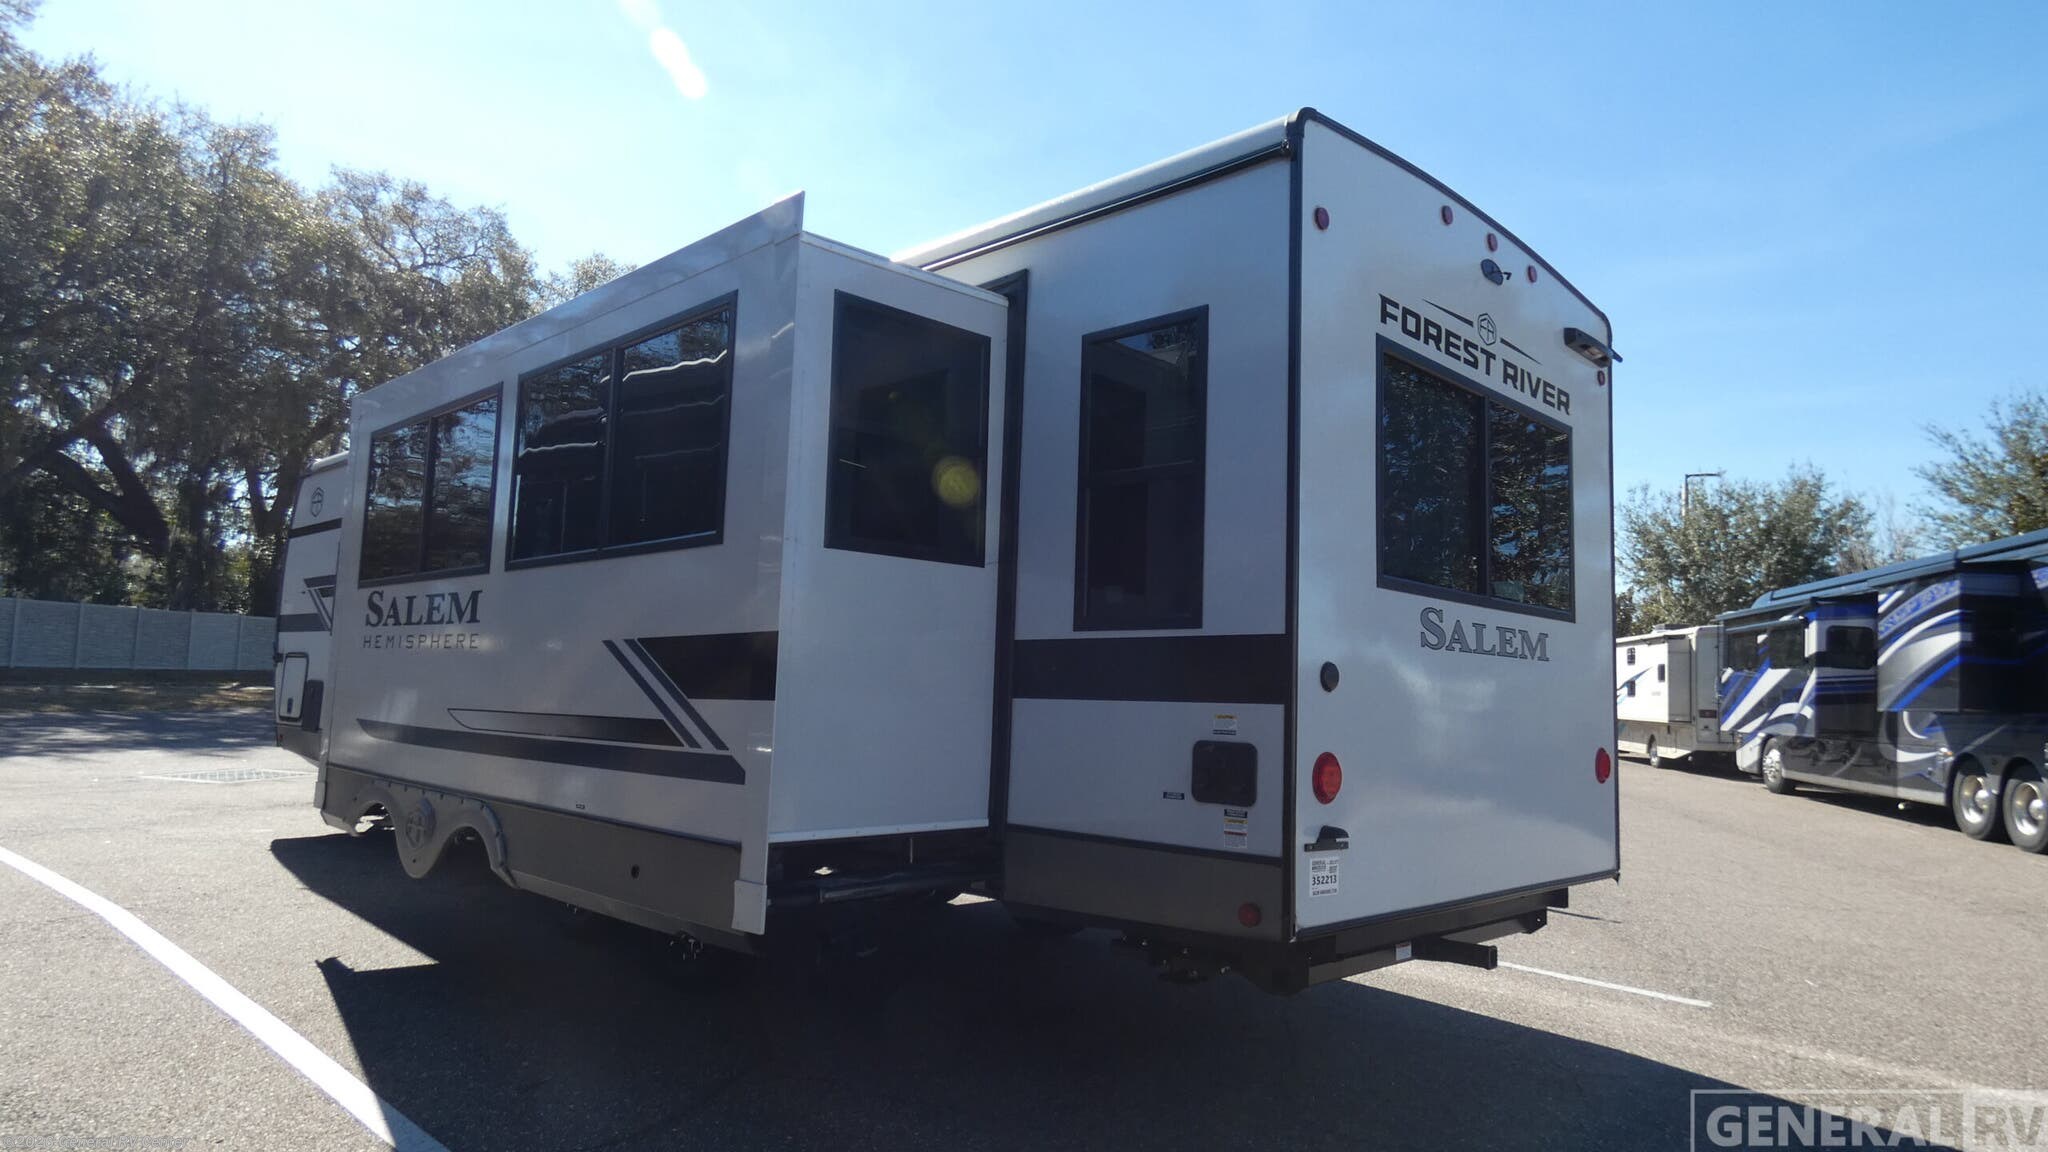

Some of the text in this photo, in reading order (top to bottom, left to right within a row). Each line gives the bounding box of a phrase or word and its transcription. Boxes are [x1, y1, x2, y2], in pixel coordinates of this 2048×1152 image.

[1378, 293, 1570, 416] FOREST RIVER
[365, 589, 483, 628] SALEM
[362, 633, 480, 650] HEMISPHERE
[1419, 606, 1550, 662] SALEM
[1311, 874, 1337, 886] 352213
